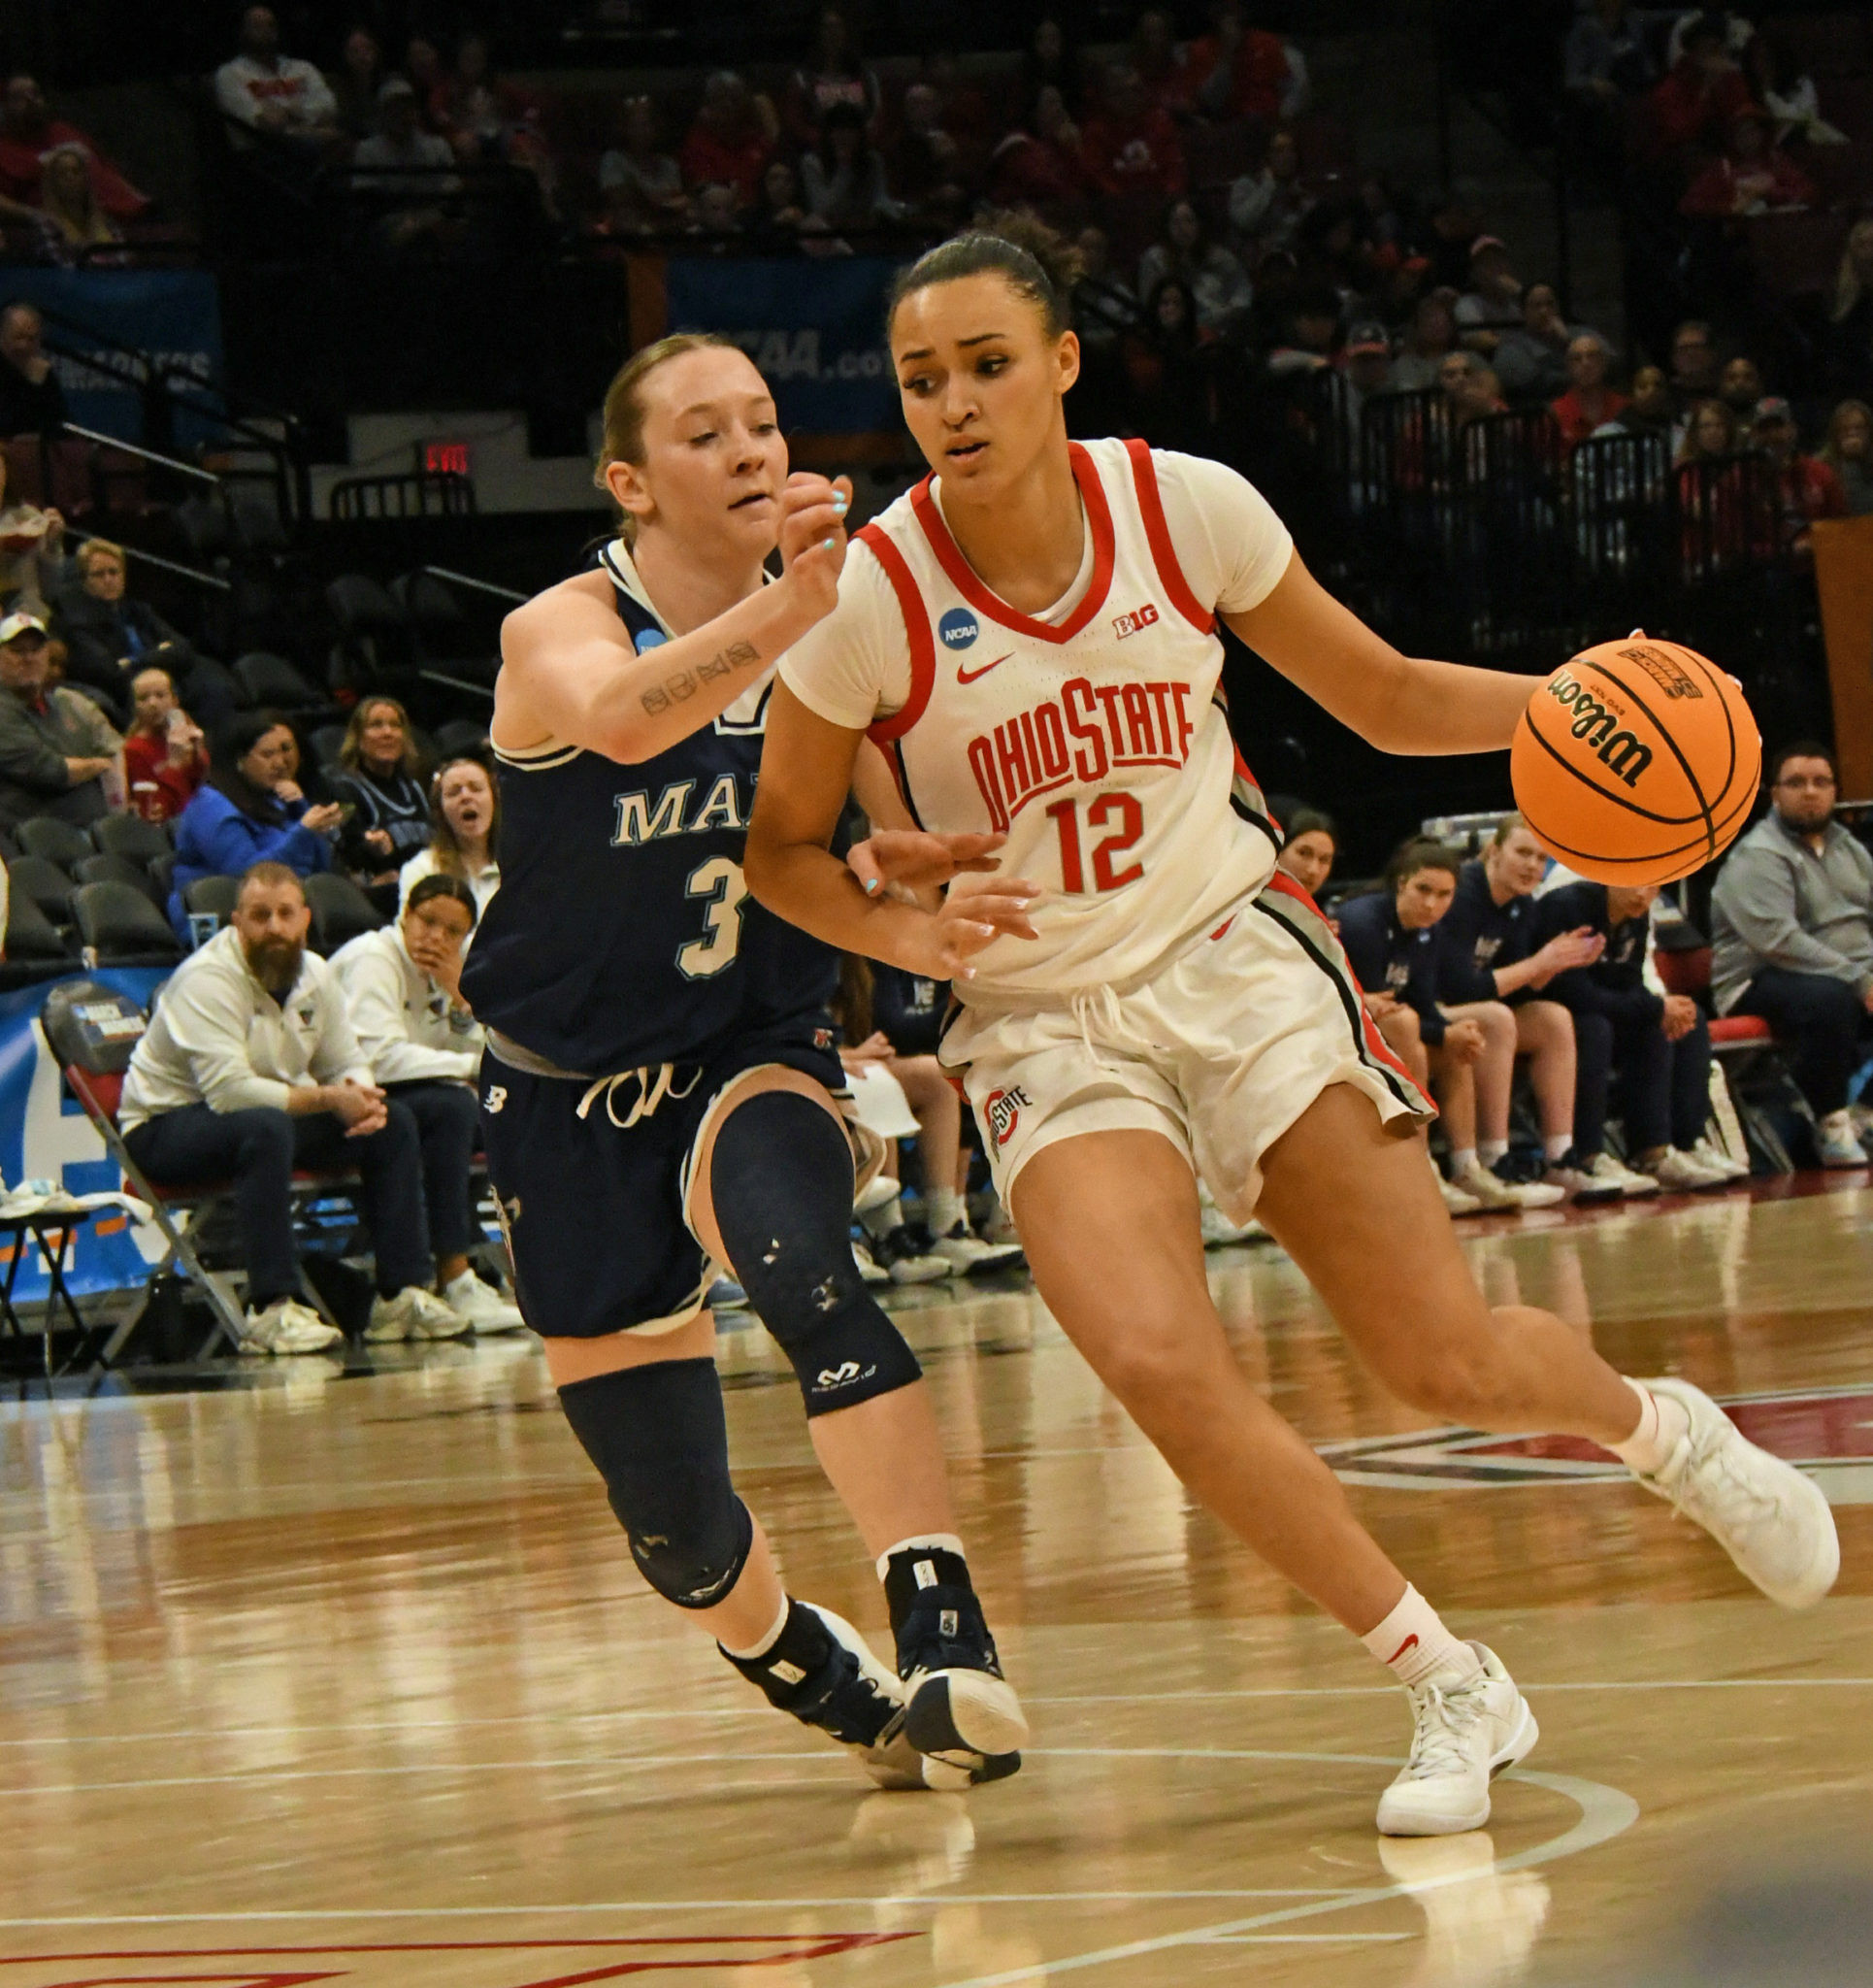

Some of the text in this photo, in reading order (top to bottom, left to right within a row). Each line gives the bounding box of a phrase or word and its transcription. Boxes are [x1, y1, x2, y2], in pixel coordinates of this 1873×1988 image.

[945, 625, 977, 642] NCAA
[968, 677, 1194, 833] OHIO STATE
[1548, 670, 1653, 788] Wilson
[1045, 791, 1144, 894] 12
[674, 854, 751, 981] 3
